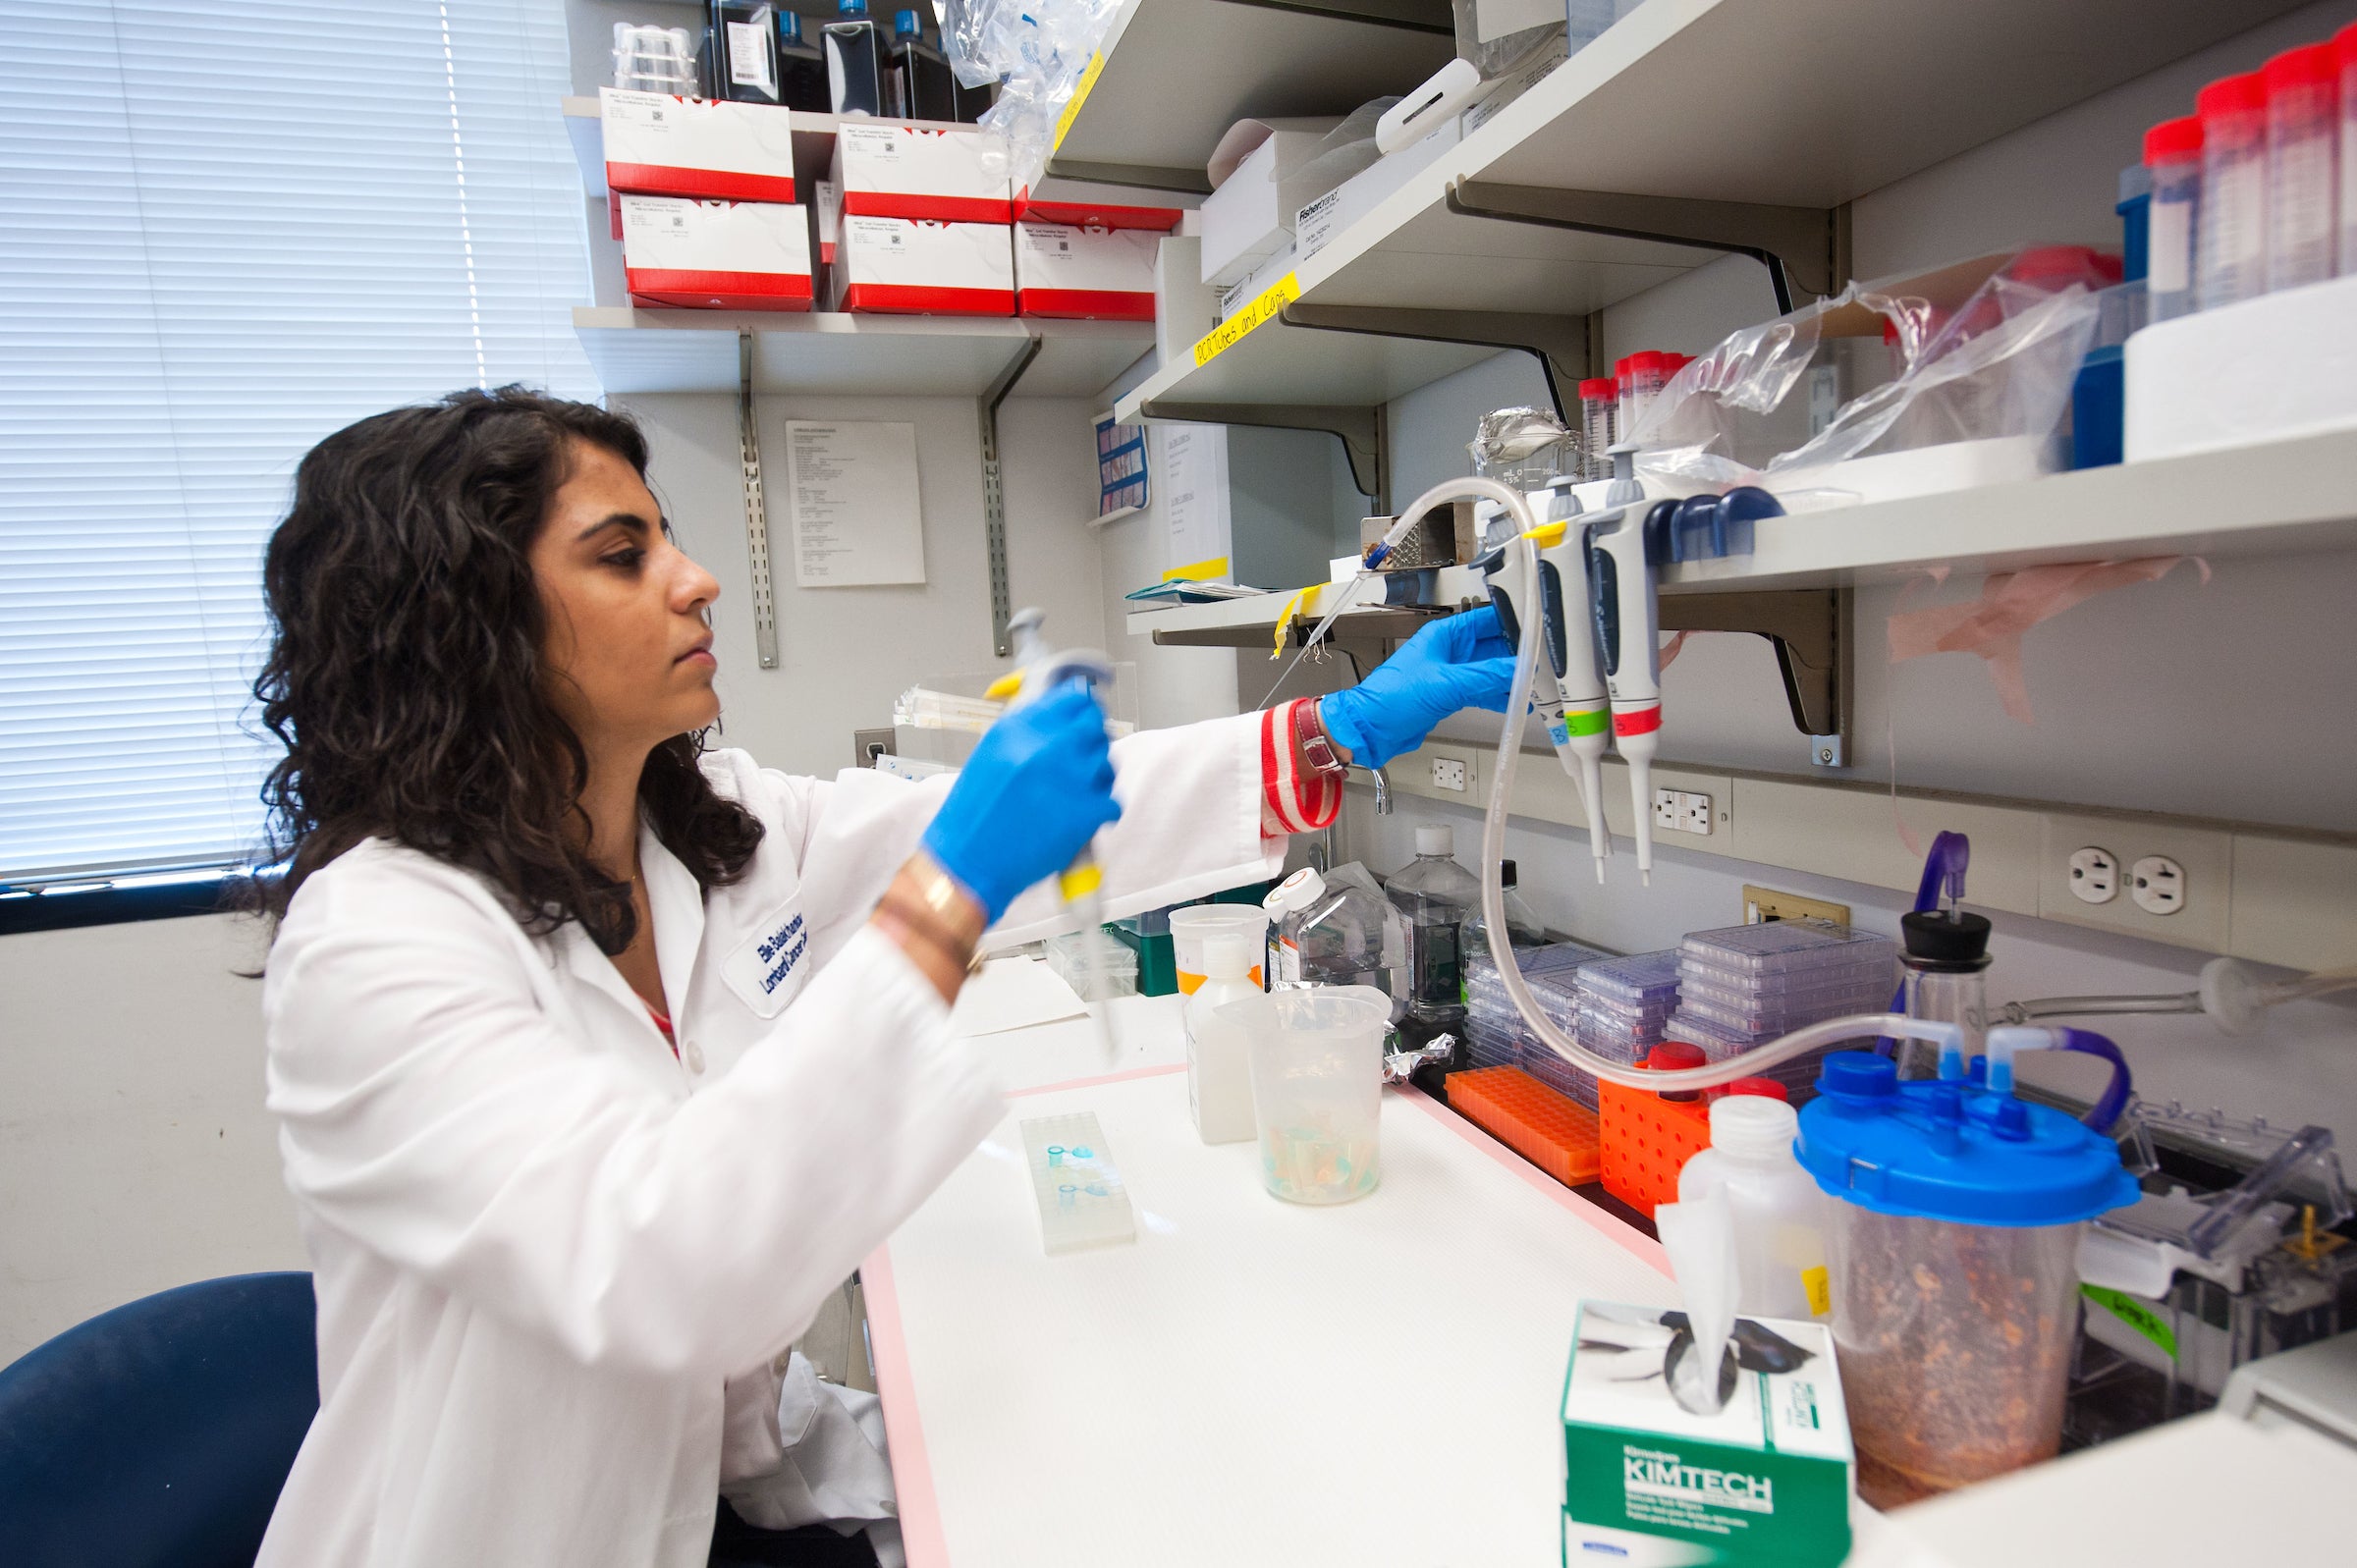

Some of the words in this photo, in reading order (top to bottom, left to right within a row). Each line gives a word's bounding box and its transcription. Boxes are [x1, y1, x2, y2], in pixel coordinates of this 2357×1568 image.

[1197, 338, 1214, 364] PCR
[1212, 326, 1236, 350] Tubes
[1241, 306, 1257, 333] and
[1263, 290, 1286, 316] Caps
[785, 940, 803, 966] Cancer
[1623, 1456, 1773, 1500] KIMTECH
